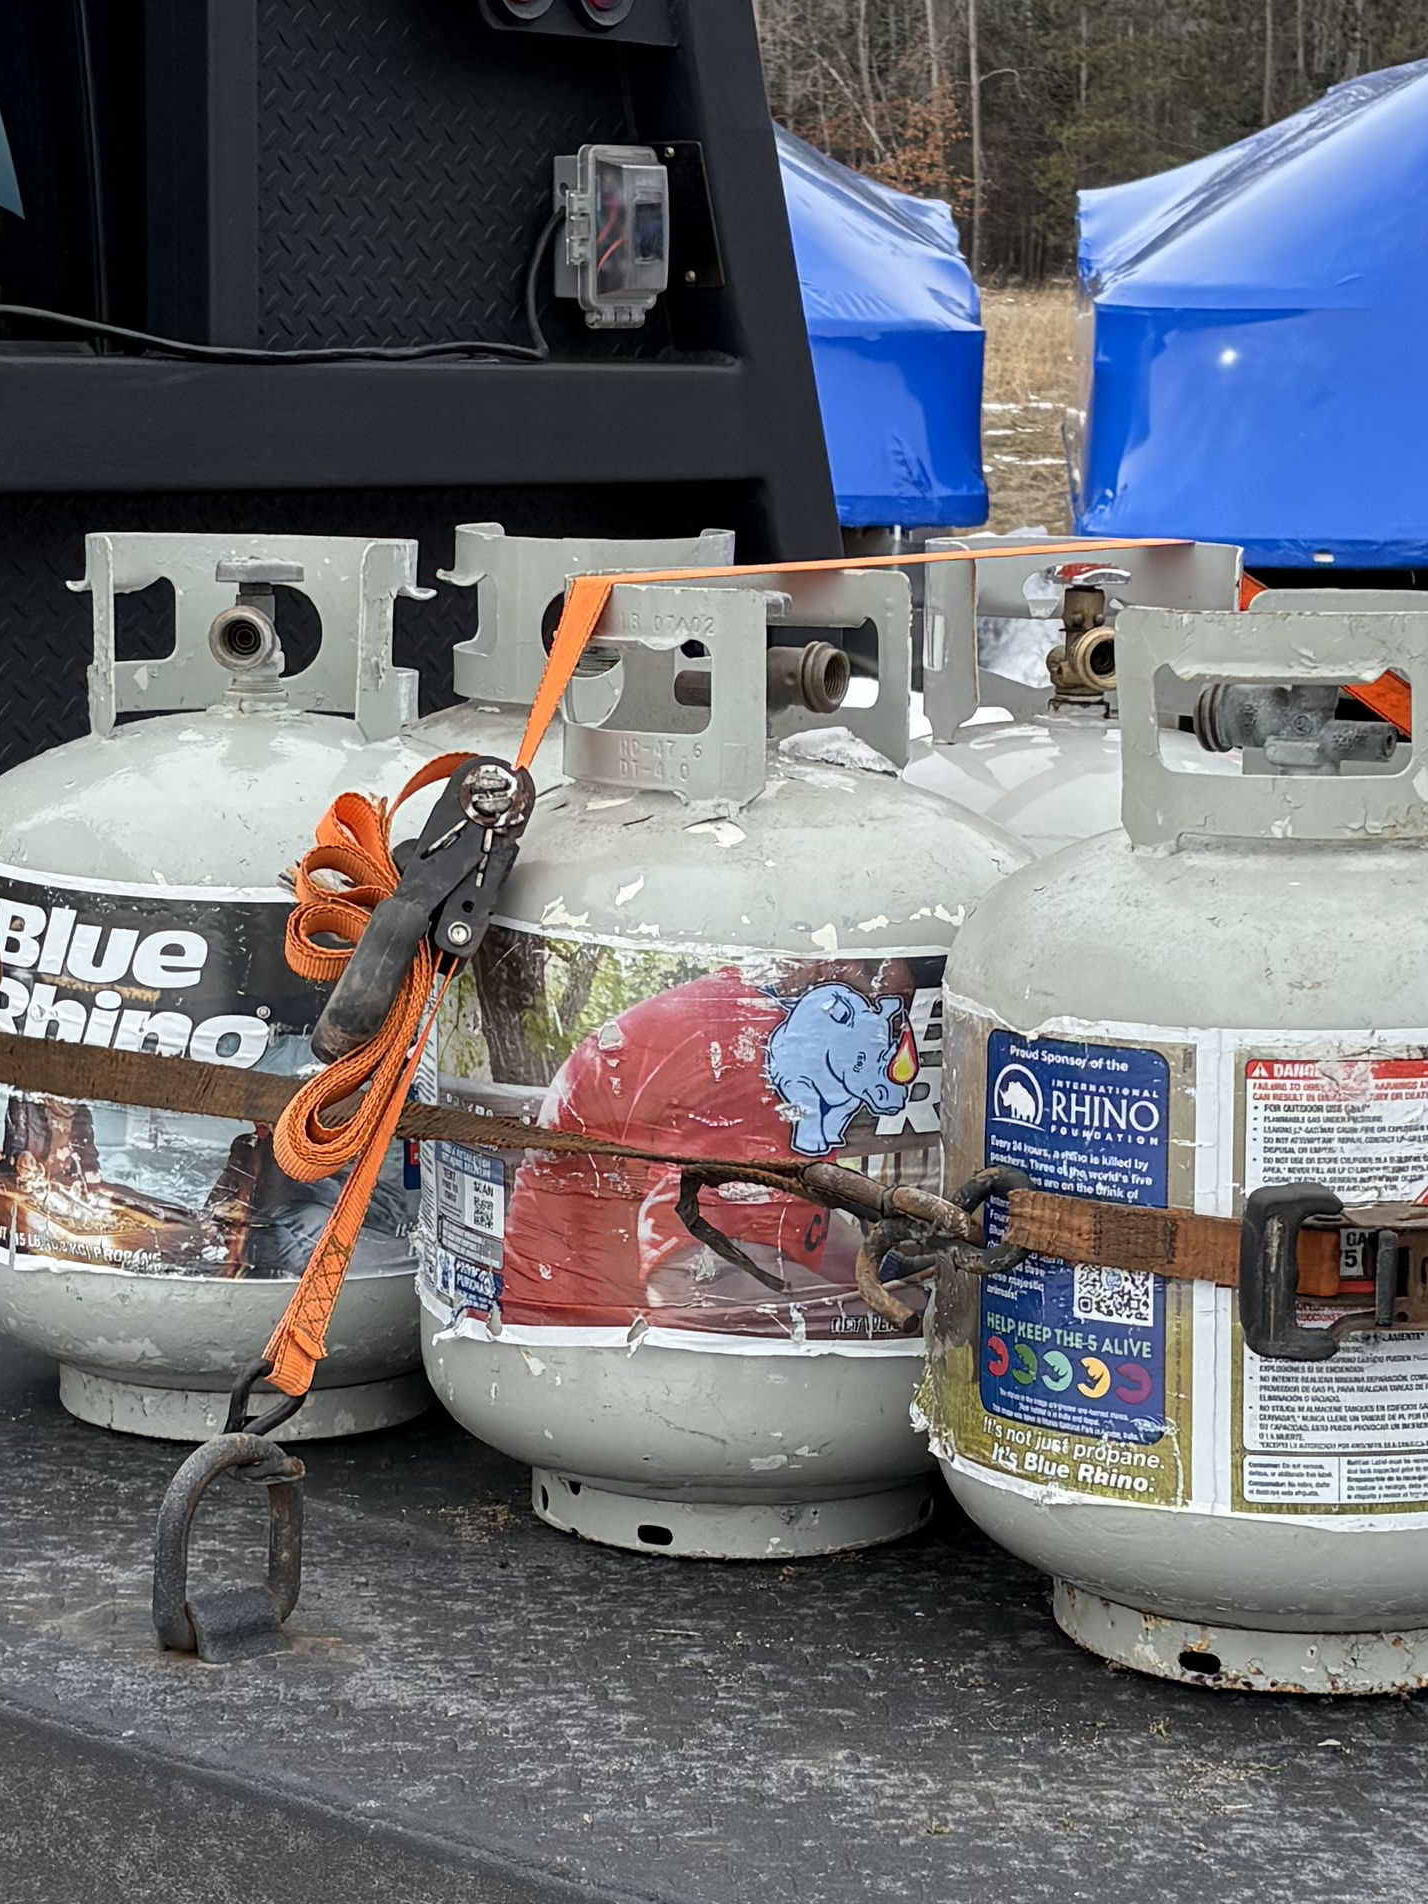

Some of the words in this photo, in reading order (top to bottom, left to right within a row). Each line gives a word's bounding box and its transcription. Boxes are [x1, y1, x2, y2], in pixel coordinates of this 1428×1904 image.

[1010, 1045, 1039, 1061] Proud
[1040, 1050, 1087, 1068] Sponsor
[1089, 1059, 1103, 1070] of
[1103, 1059, 1129, 1073] the
[1273, 1063, 1319, 1078] DANG
[1051, 1079, 1159, 1099] INTERNATIONAL
[1051, 1090, 1160, 1132] RHINO
[1283, 1104, 1324, 1112] OUTDOOR
[1050, 1124, 1159, 1146] FOUNDATION
[1029, 1158, 1055, 1174] Three
[986, 1311, 1016, 1334] HELP
[1018, 1319, 1051, 1340] KEEP
[1054, 1328, 1083, 1349] THE
[1101, 1338, 1152, 1359] ALIVE
[983, 1416, 1003, 1437] It's
[1006, 1426, 1032, 1446] not
[1034, 1431, 1069, 1454] just
[1073, 1443, 1165, 1470] propane.
[991, 1445, 1018, 1469] It's
[1024, 1453, 1070, 1479] Blue
